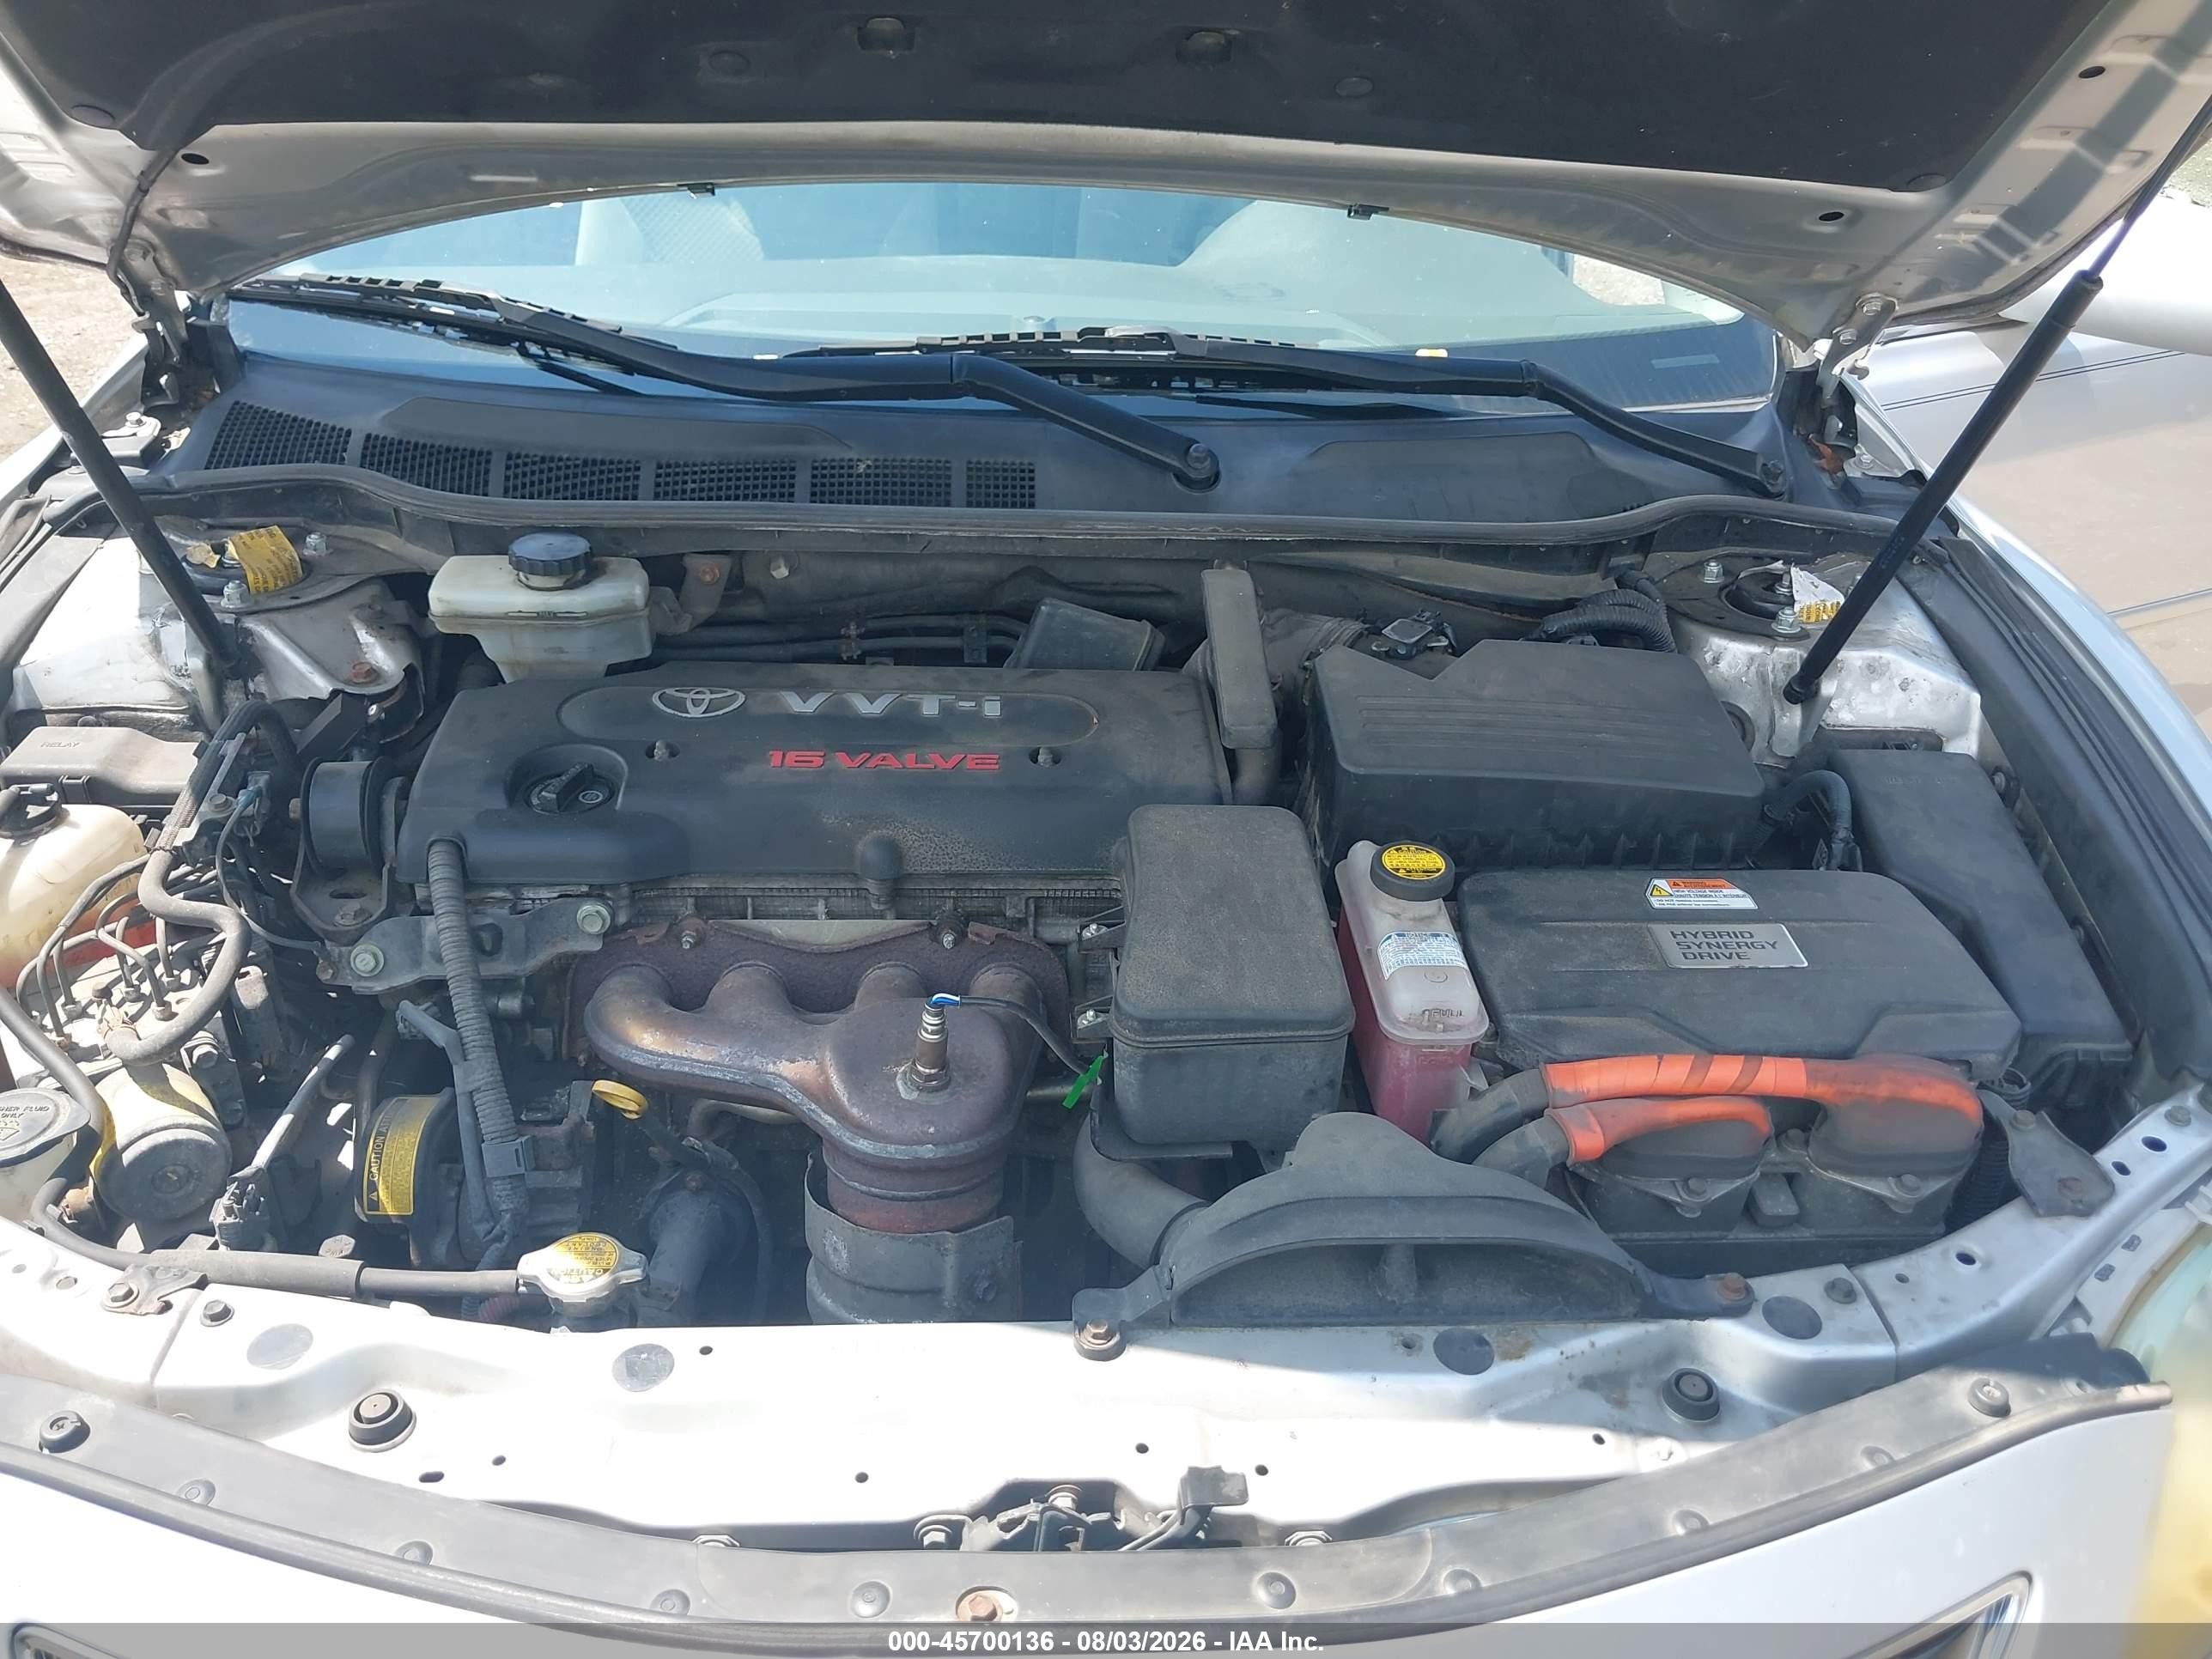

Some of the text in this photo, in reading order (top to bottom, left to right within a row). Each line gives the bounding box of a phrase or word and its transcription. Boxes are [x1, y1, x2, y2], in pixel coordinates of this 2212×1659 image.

[780, 690, 1002, 717] VVT-i
[769, 750, 1000, 770] 16 VALVE
[1670, 931, 1754, 939] HYBRID
[1676, 941, 1778, 950] SYNERGY
[1681, 951, 1751, 960] DRIVE
[368, 1134, 386, 1181] CAUTION
